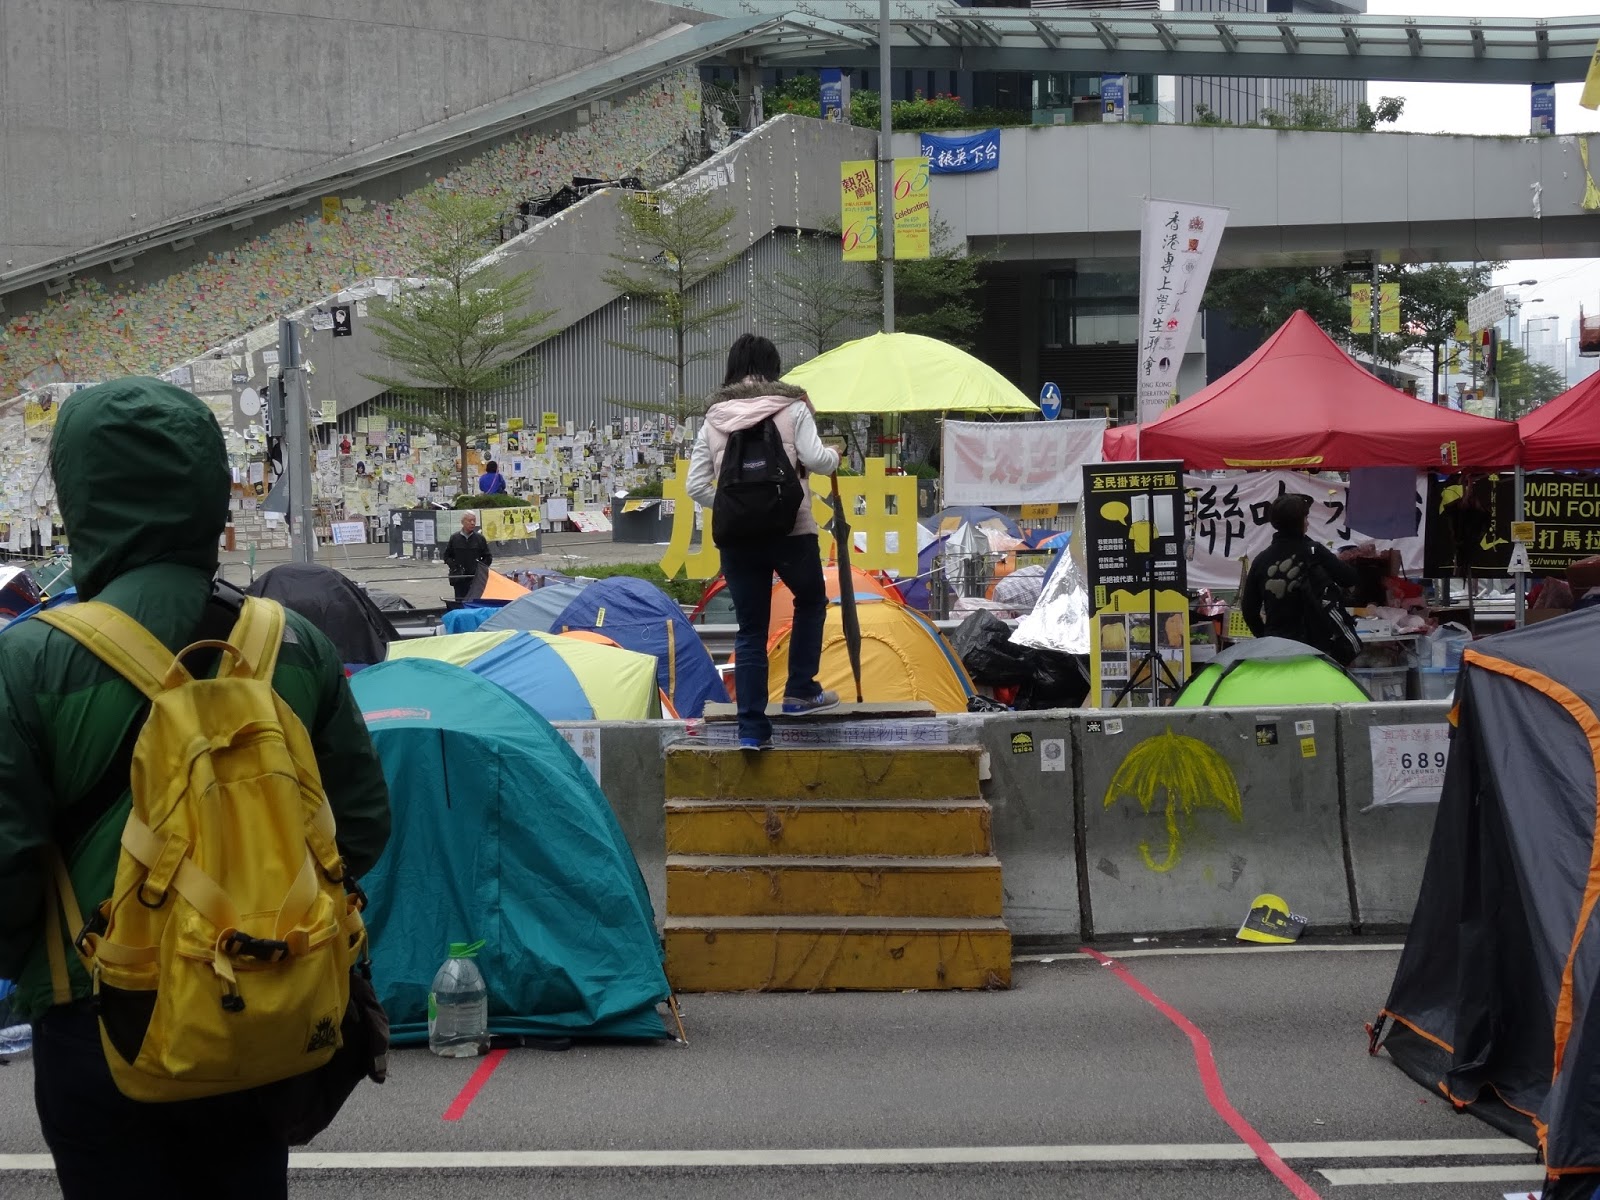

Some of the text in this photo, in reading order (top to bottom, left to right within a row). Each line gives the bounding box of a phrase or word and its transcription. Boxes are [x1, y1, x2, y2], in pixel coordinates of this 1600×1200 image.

[894, 164, 929, 200] 65
[895, 201, 930, 220] Celebrating
[842, 216, 877, 251] 65
[1093, 474, 1176, 489] 全民掛黃衫行動
[1401, 752, 1445, 769] 689
